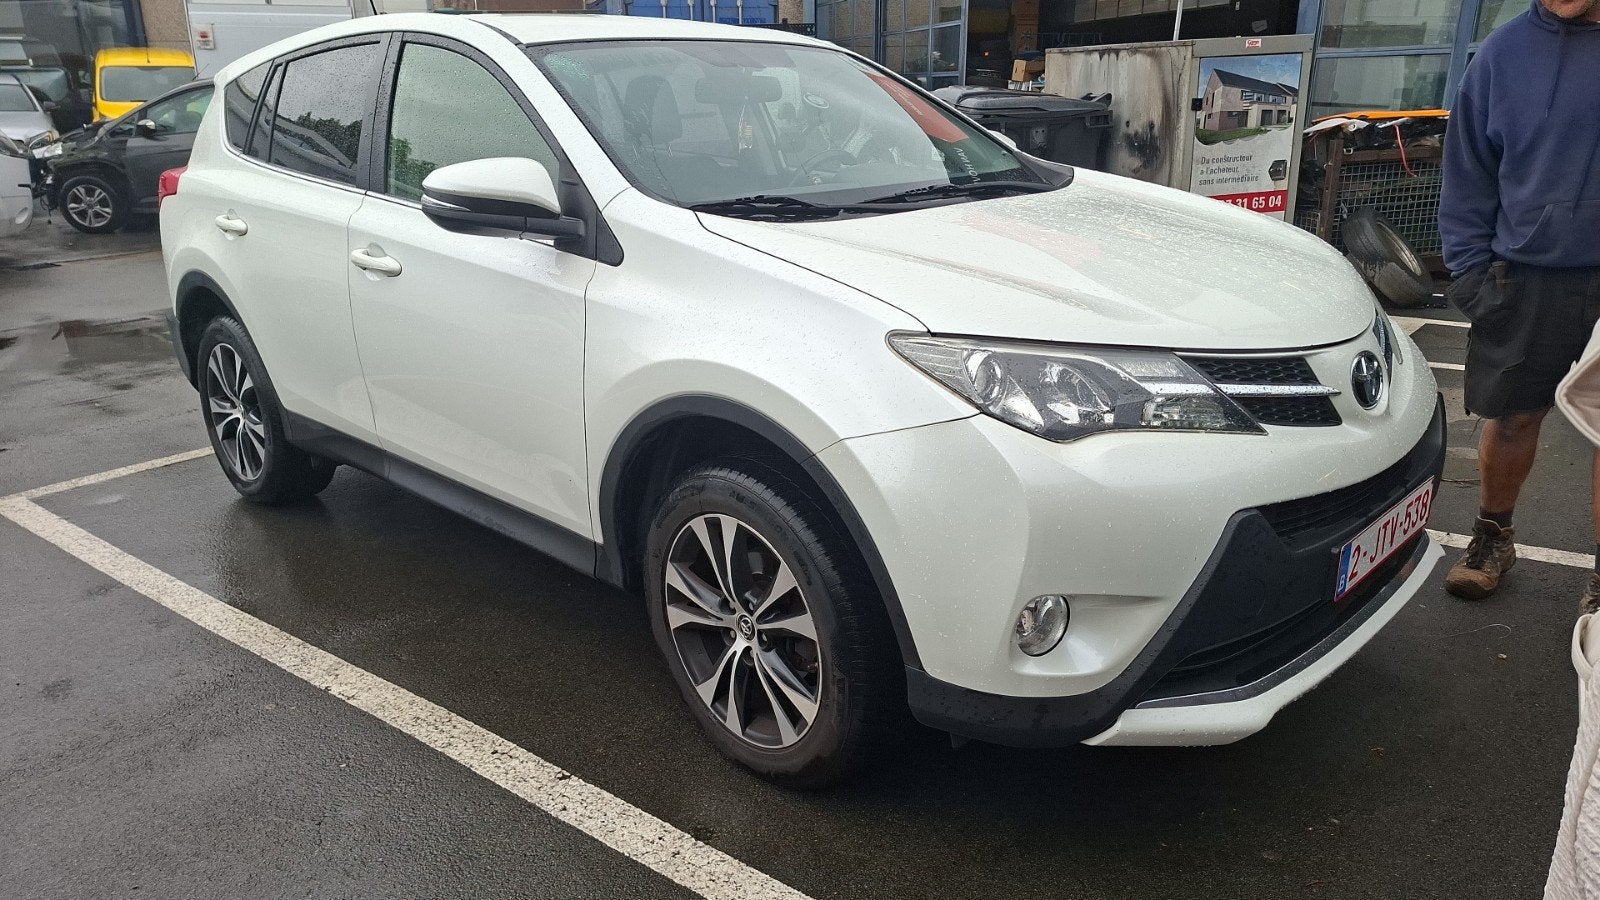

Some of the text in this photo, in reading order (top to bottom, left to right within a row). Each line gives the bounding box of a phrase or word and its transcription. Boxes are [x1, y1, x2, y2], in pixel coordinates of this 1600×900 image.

[1201, 154, 1253, 165] Du constructeur
[1199, 173, 1259, 186] sans intermédiaire
[1252, 196, 1266, 209] 65
[1268, 194, 1282, 208] 04
[1348, 488, 1431, 583] 2-JTV-538
